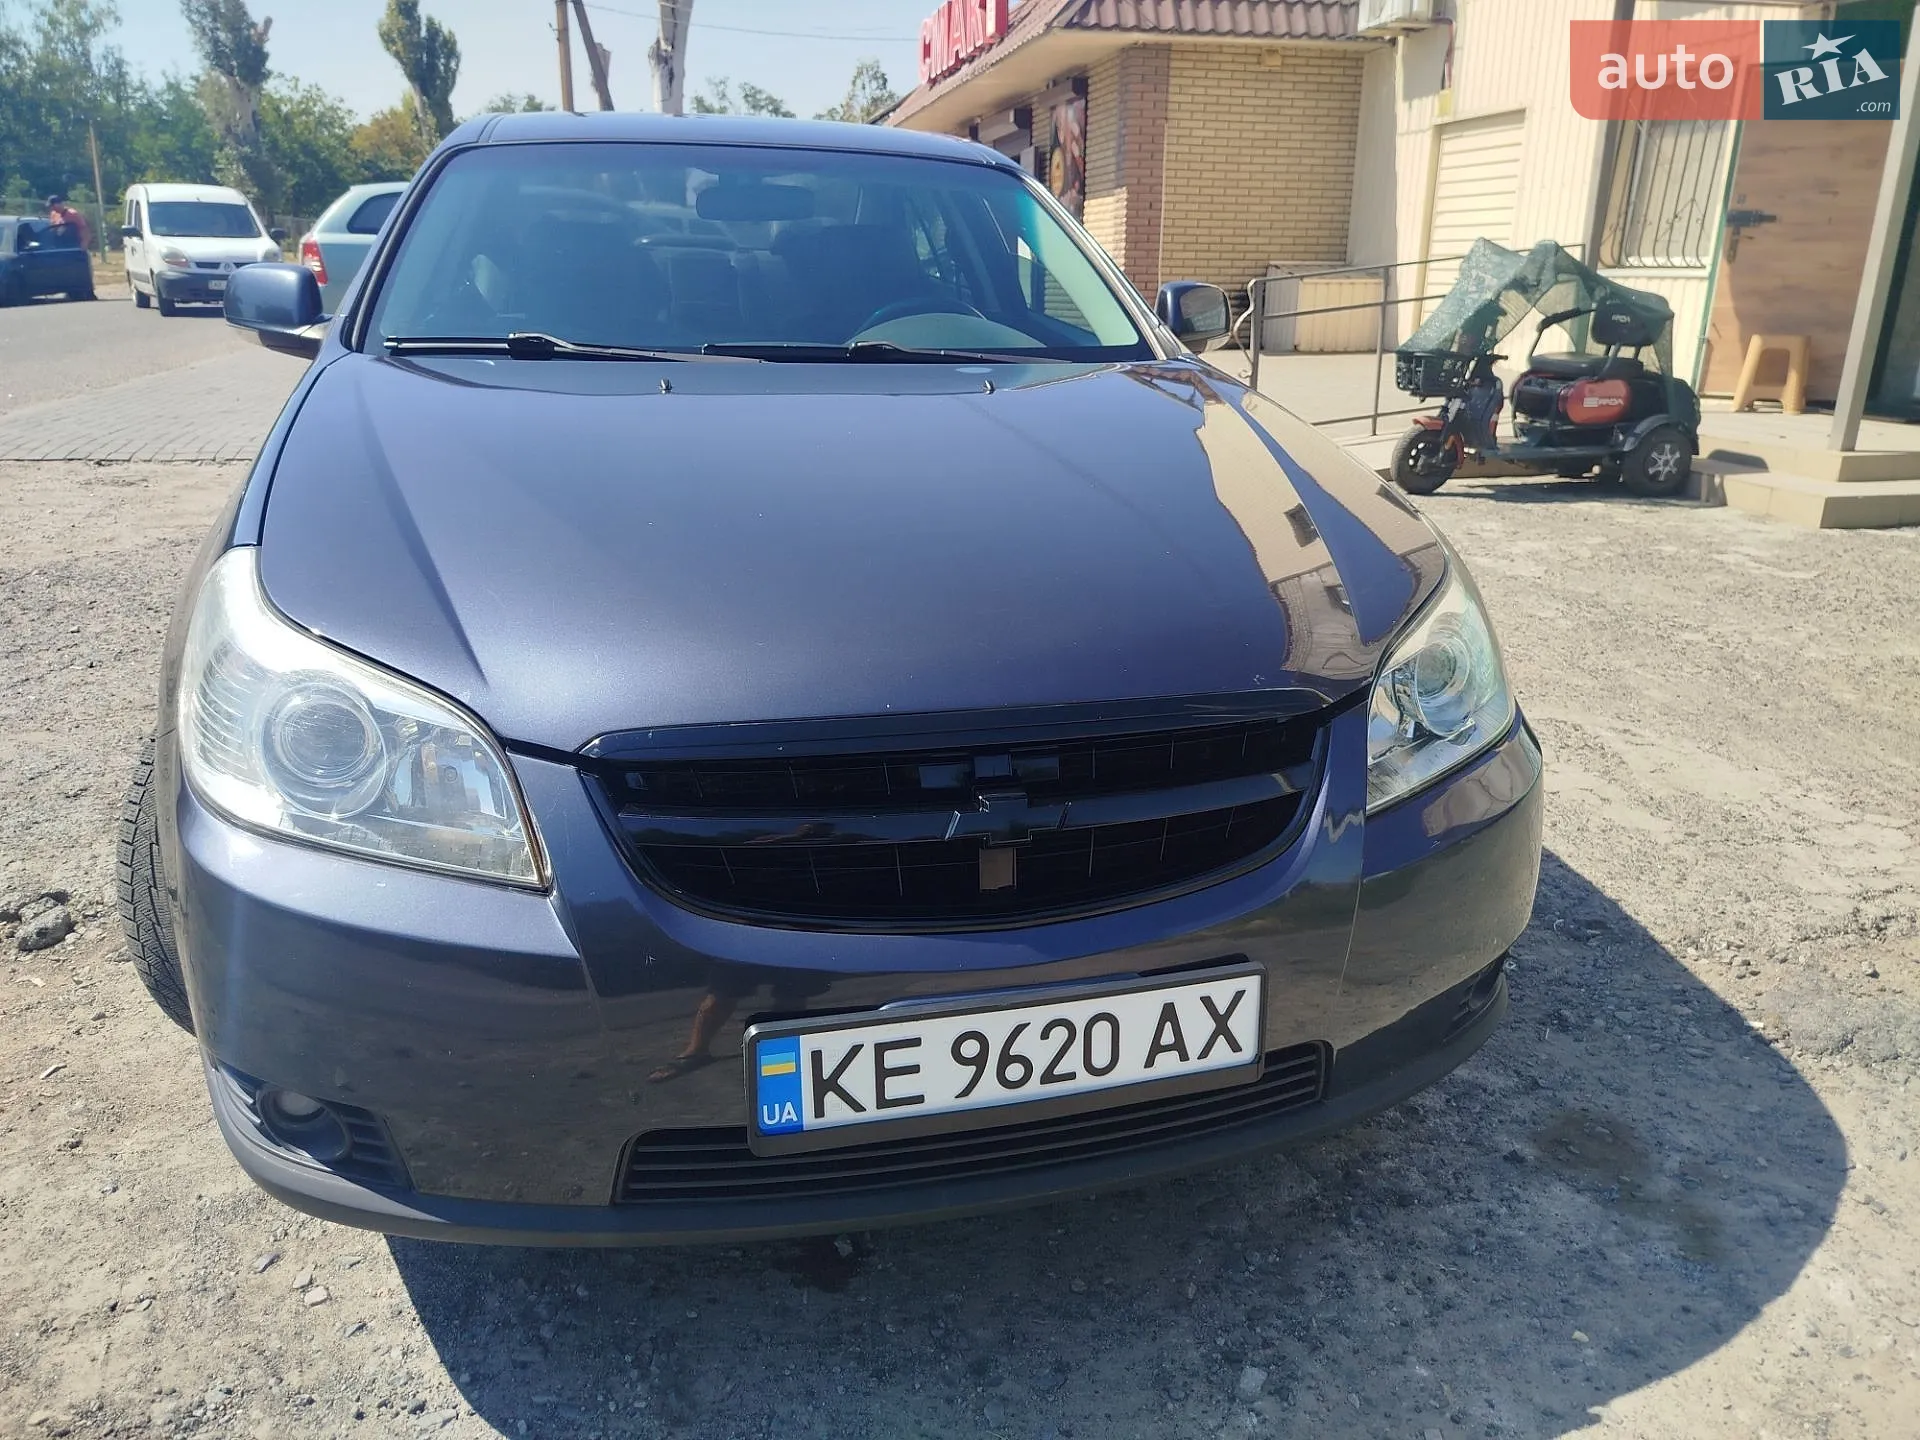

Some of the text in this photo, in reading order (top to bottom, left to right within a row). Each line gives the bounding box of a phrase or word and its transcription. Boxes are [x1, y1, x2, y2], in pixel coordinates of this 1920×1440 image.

[811, 990, 1246, 1119] KE 9620 AX
[762, 1103, 798, 1125] UA
